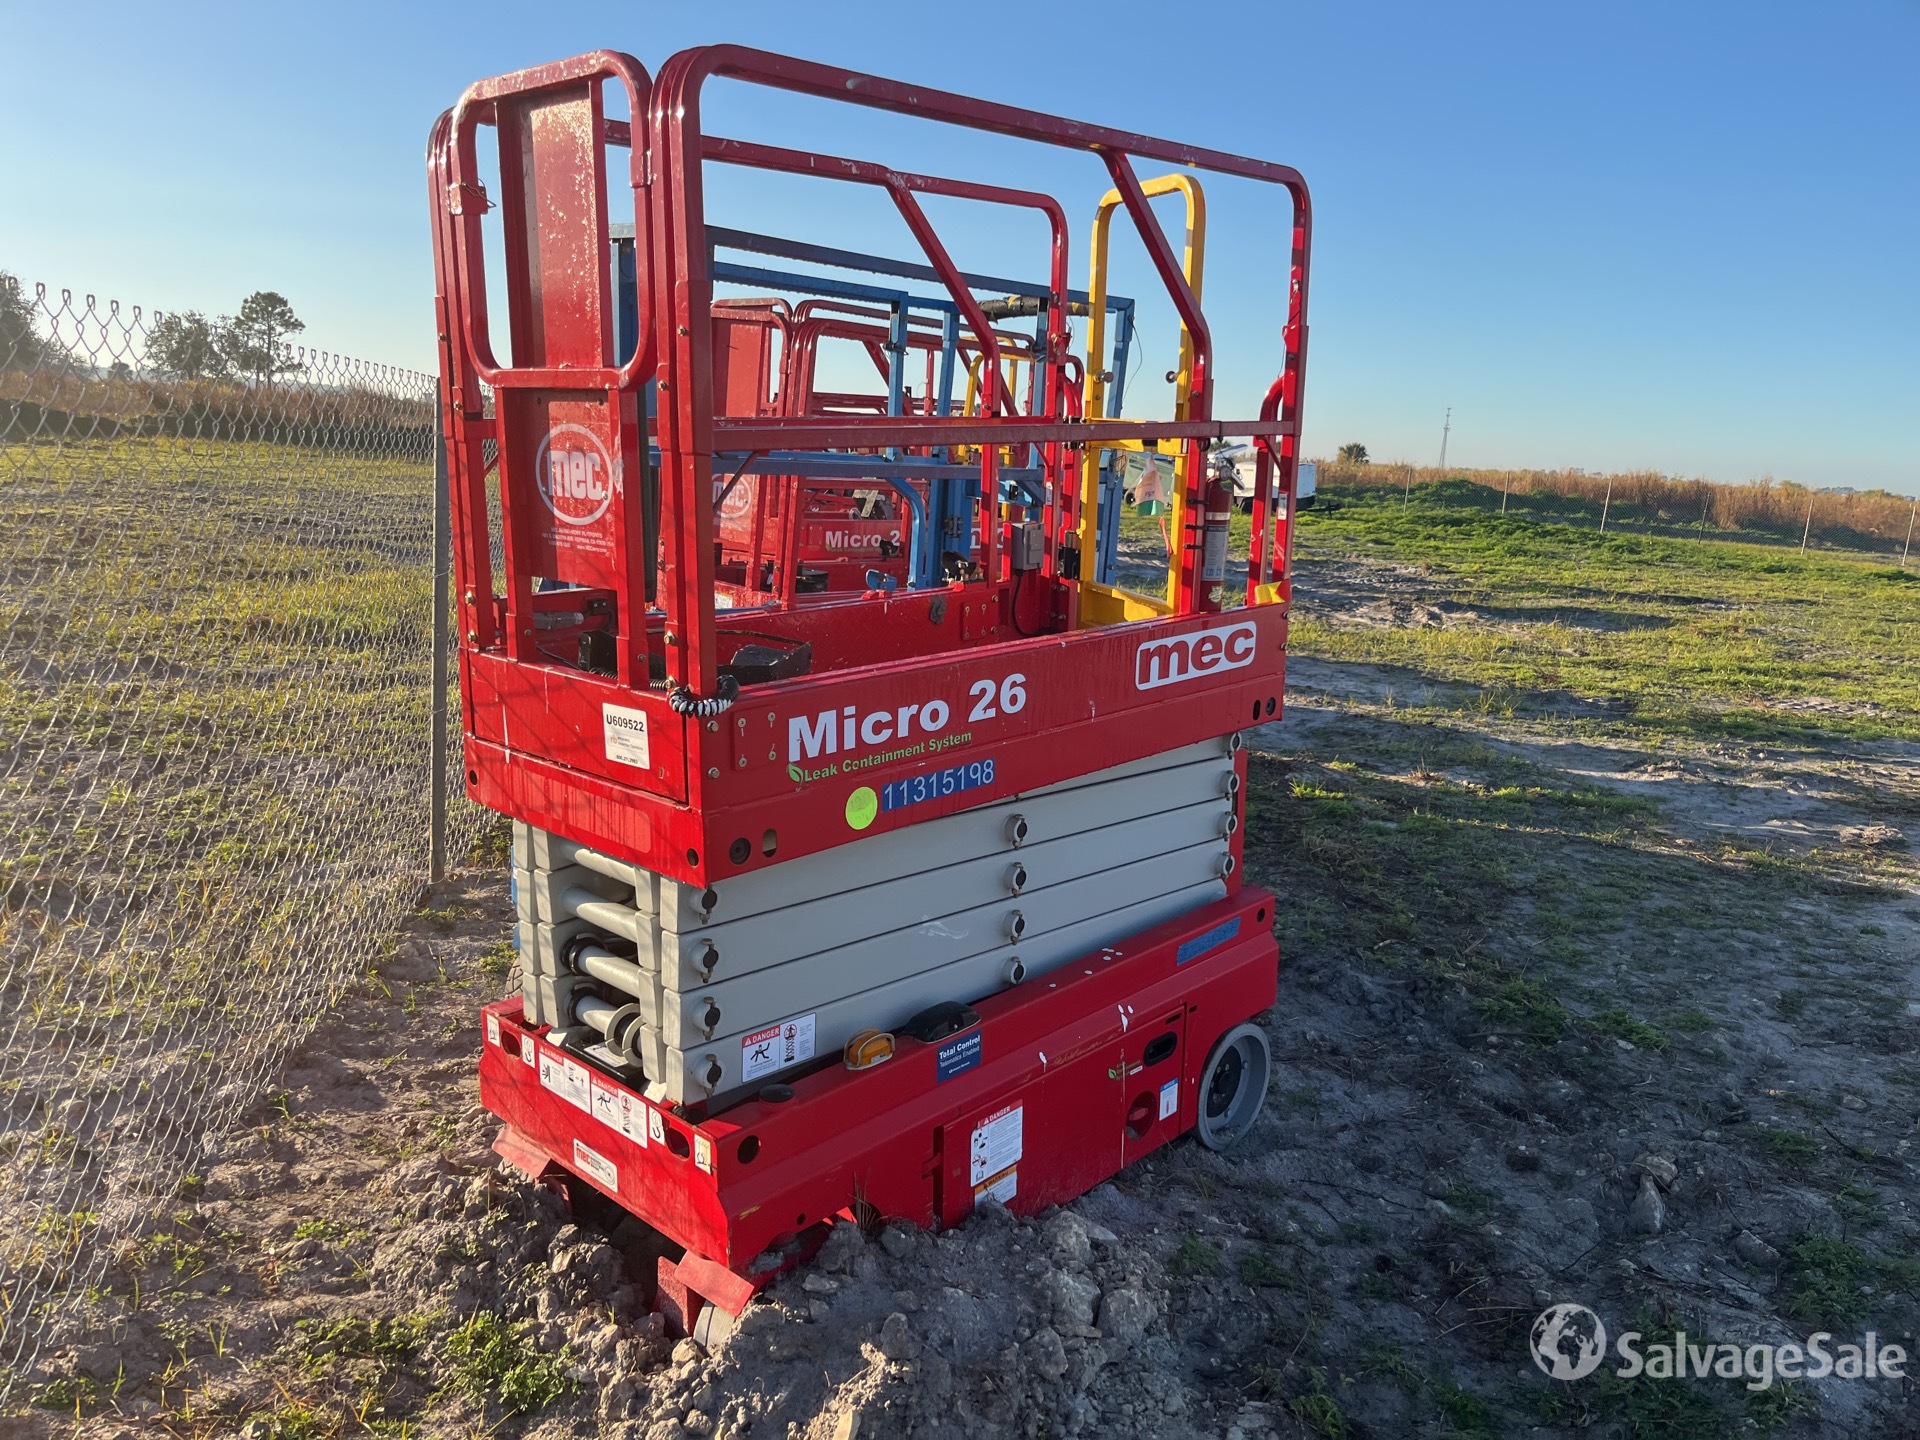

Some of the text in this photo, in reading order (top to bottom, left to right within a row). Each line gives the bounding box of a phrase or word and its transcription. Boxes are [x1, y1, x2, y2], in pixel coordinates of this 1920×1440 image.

[547, 450, 602, 500] mec
[826, 530, 881, 548] Micro
[1138, 628, 1255, 685] mec
[606, 714, 645, 732] U609522
[788, 673, 1027, 763] Micro 26
[804, 732, 972, 782] Leak Containment System
[884, 759, 994, 810] 11315198
[752, 1028, 780, 1043] DANGER
[939, 1034, 981, 1059] Total Control
[597, 1079, 618, 1096] DANGER
[989, 1106, 1011, 1122] DANGER
